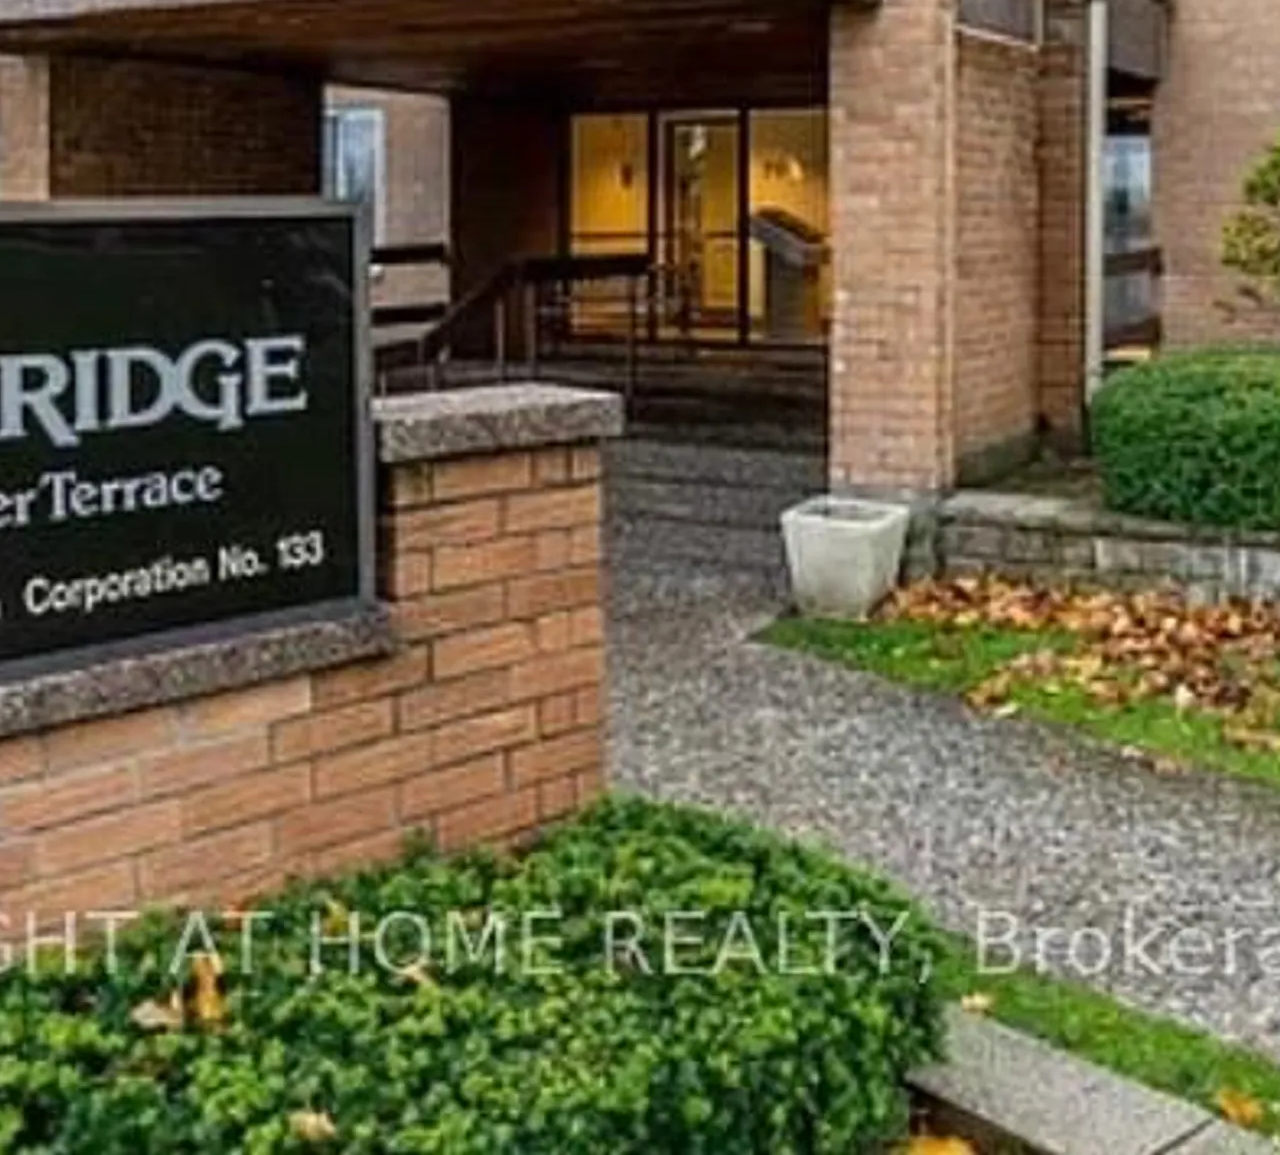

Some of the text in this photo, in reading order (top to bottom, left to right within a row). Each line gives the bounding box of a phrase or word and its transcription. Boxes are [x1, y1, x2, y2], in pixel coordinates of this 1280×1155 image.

[38, 463, 224, 522] Terrace
[23, 553, 209, 616] Corporation
[218, 543, 266, 581] No.
[276, 530, 323, 569] 133
